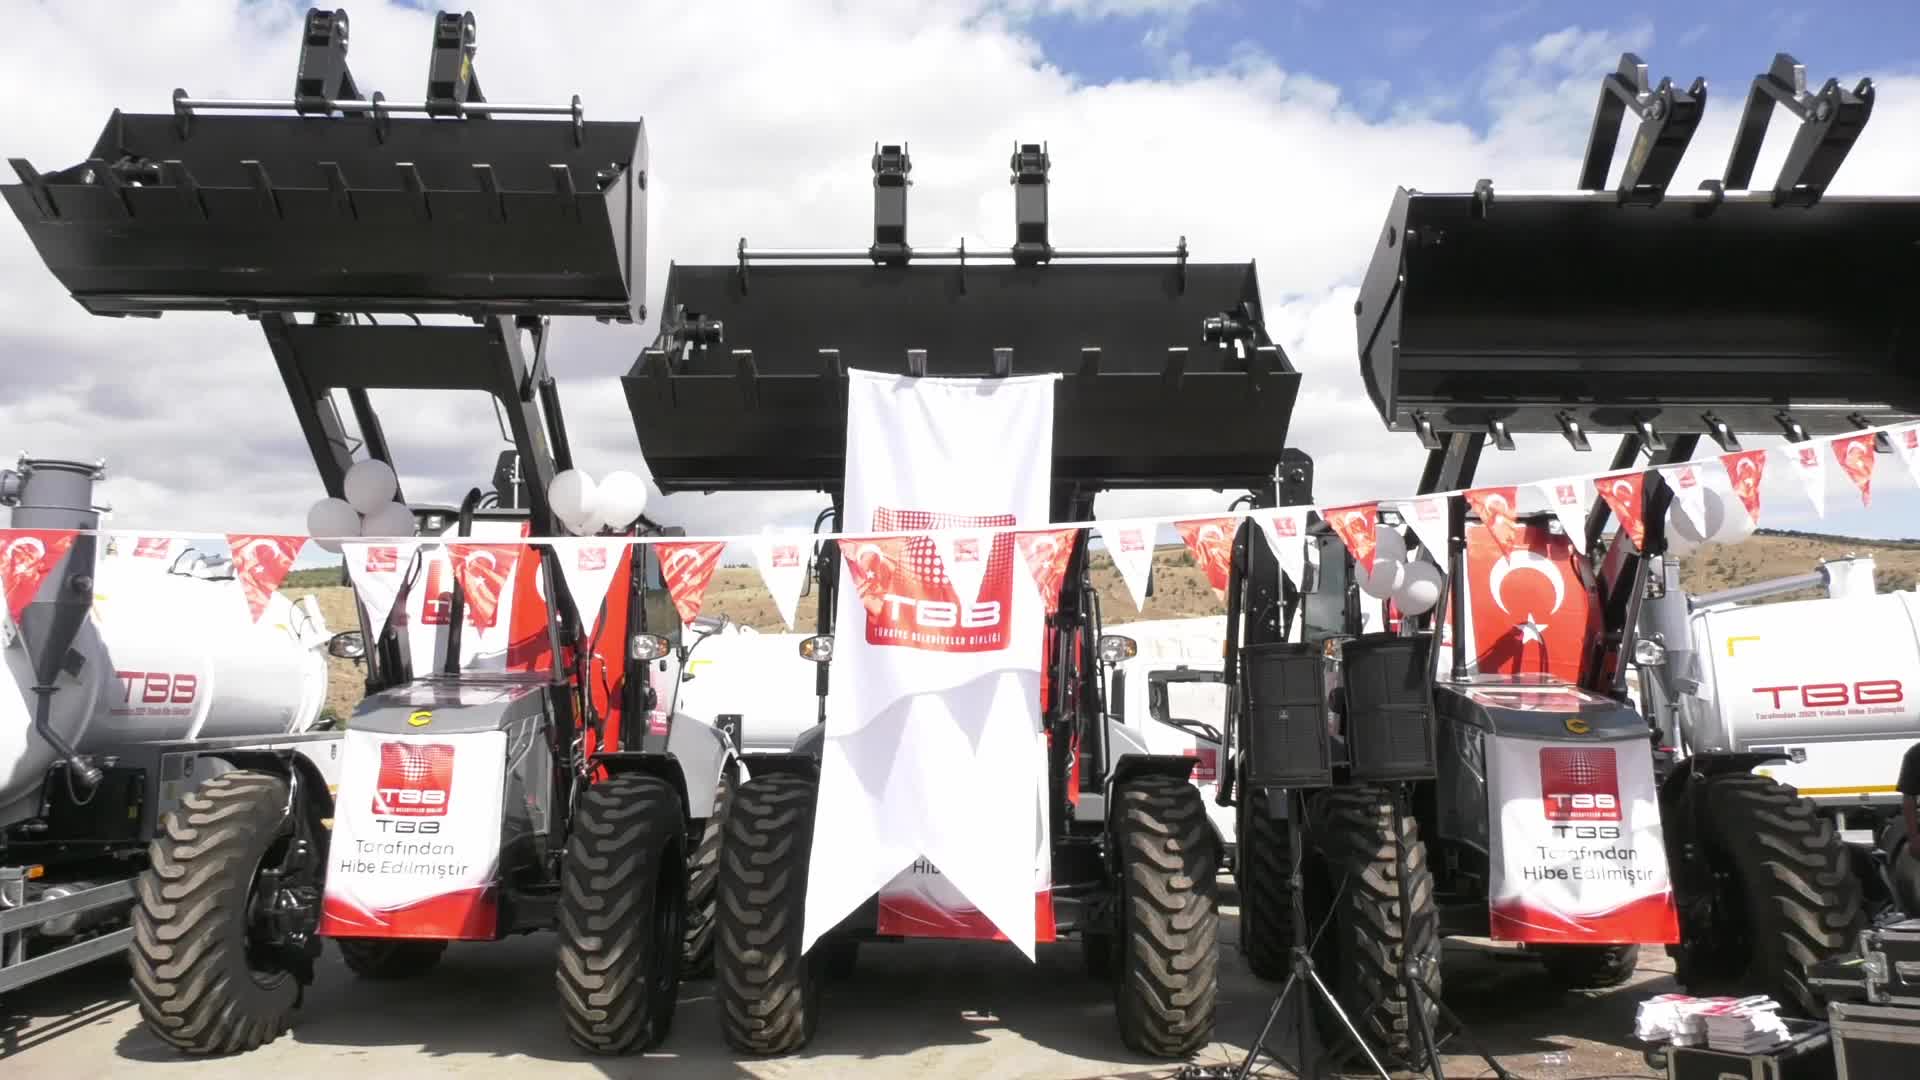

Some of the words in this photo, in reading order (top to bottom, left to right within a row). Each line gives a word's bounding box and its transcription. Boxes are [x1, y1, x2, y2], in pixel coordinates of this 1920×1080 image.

[884, 594, 1000, 628] TBB
[115, 671, 196, 703] TBB
[1752, 680, 1903, 709] TBB
[379, 788, 446, 805] TBB
[1548, 793, 1616, 809] TBB
[376, 819, 440, 834] TBB
[1552, 825, 1620, 839] TBB
[356, 839, 454, 855] Tarafından
[340, 859, 376, 874] Hibe
[1523, 865, 1569, 881] Hibe
